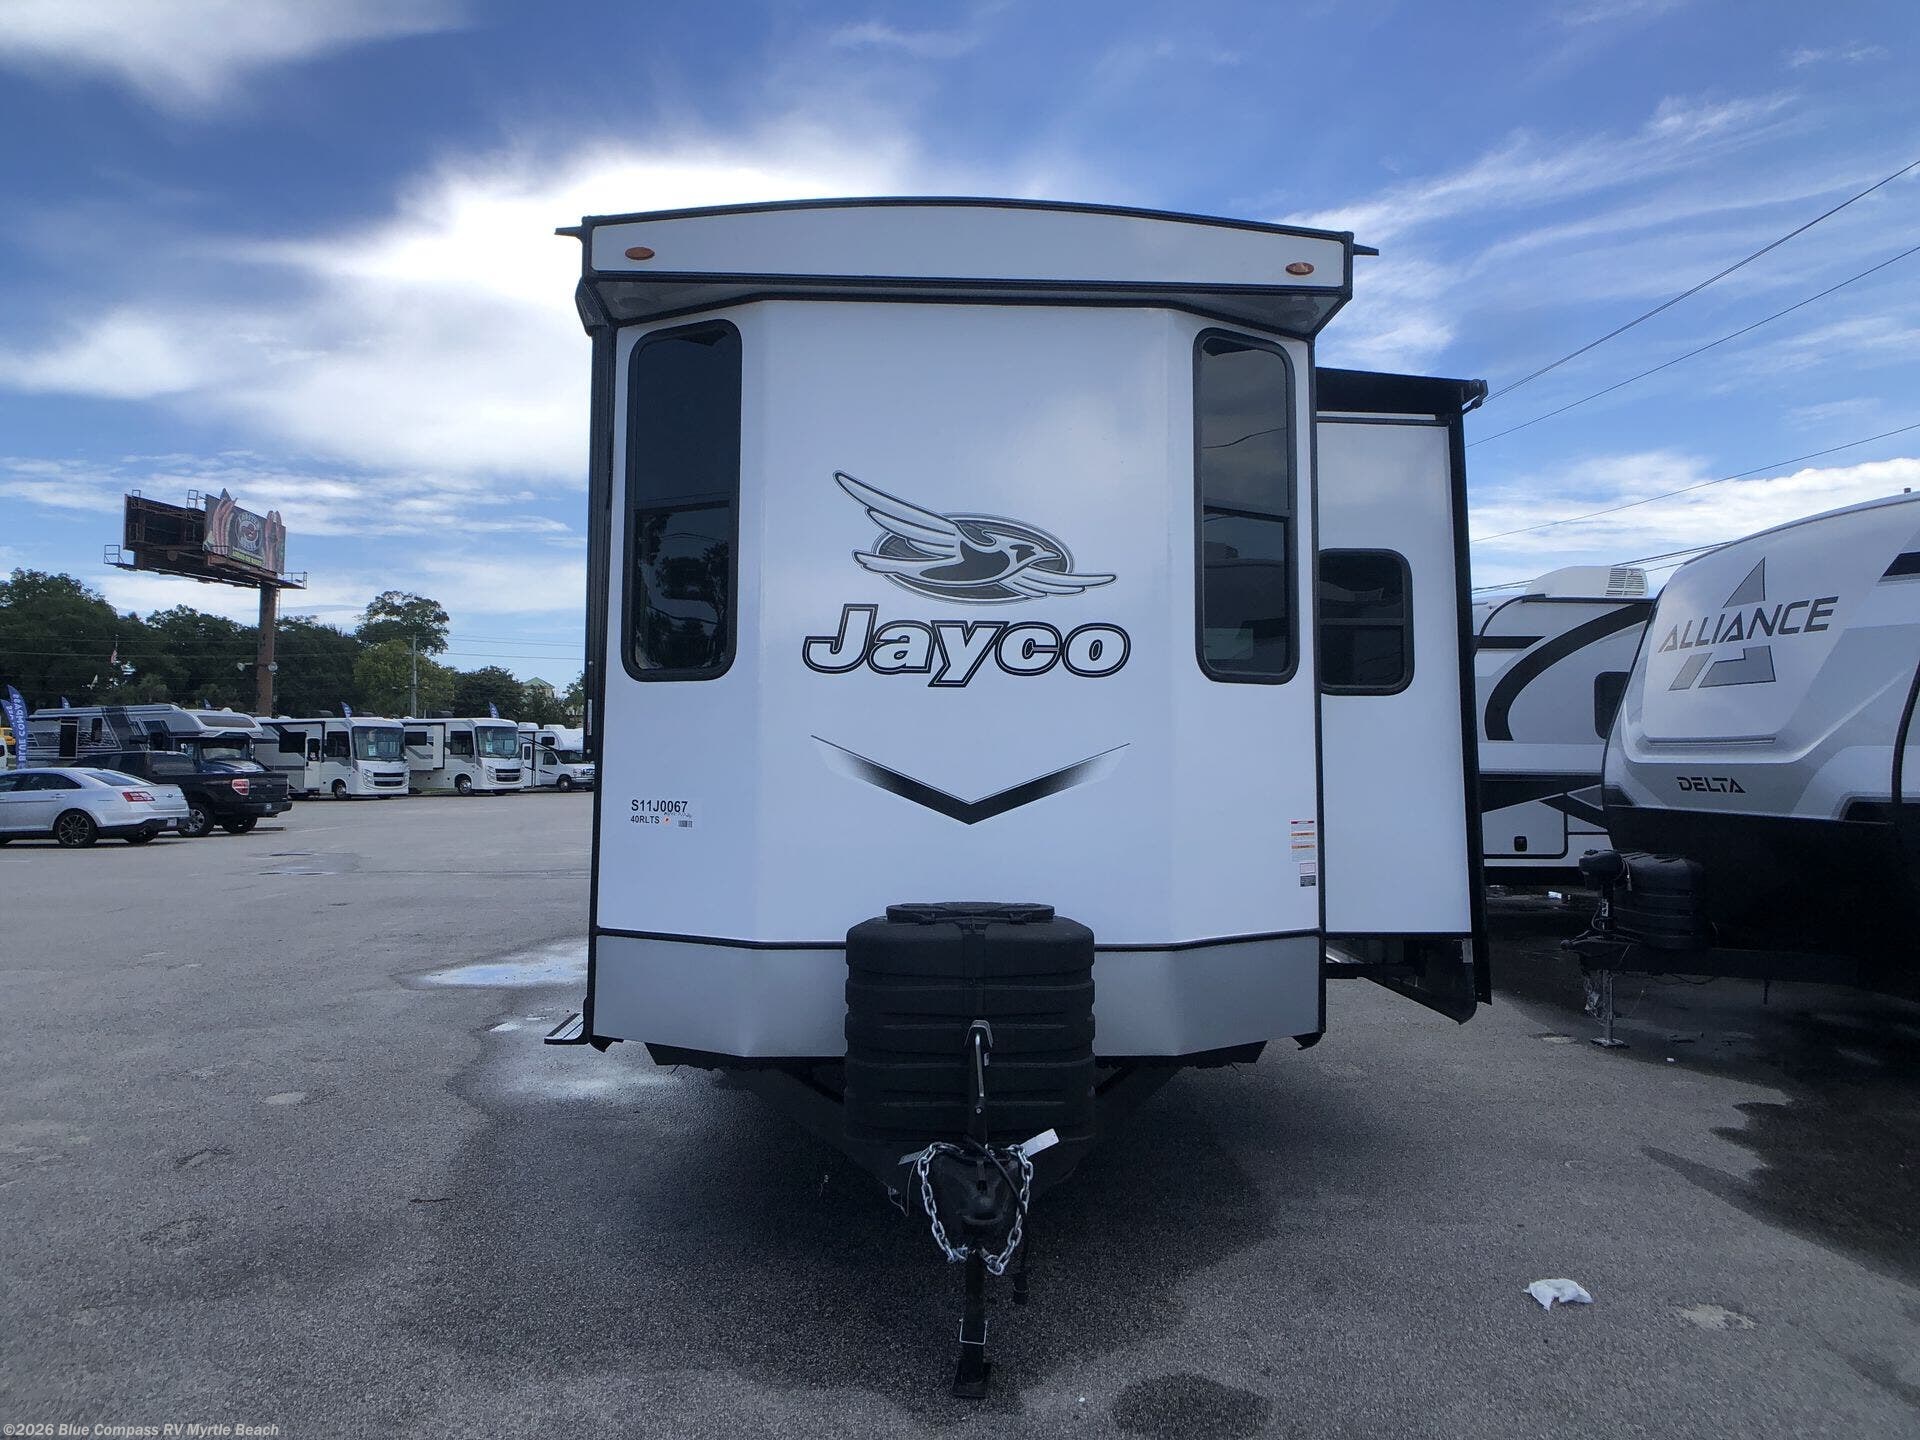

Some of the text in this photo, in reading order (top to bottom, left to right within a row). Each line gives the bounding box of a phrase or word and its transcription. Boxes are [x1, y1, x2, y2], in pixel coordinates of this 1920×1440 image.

[1659, 596, 1839, 653] ALLIANCE
[802, 604, 1131, 687] Jayco
[1677, 776, 1747, 794] DELTA
[631, 799, 689, 813] S11J0067
[630, 814, 661, 825] 40RLTS
